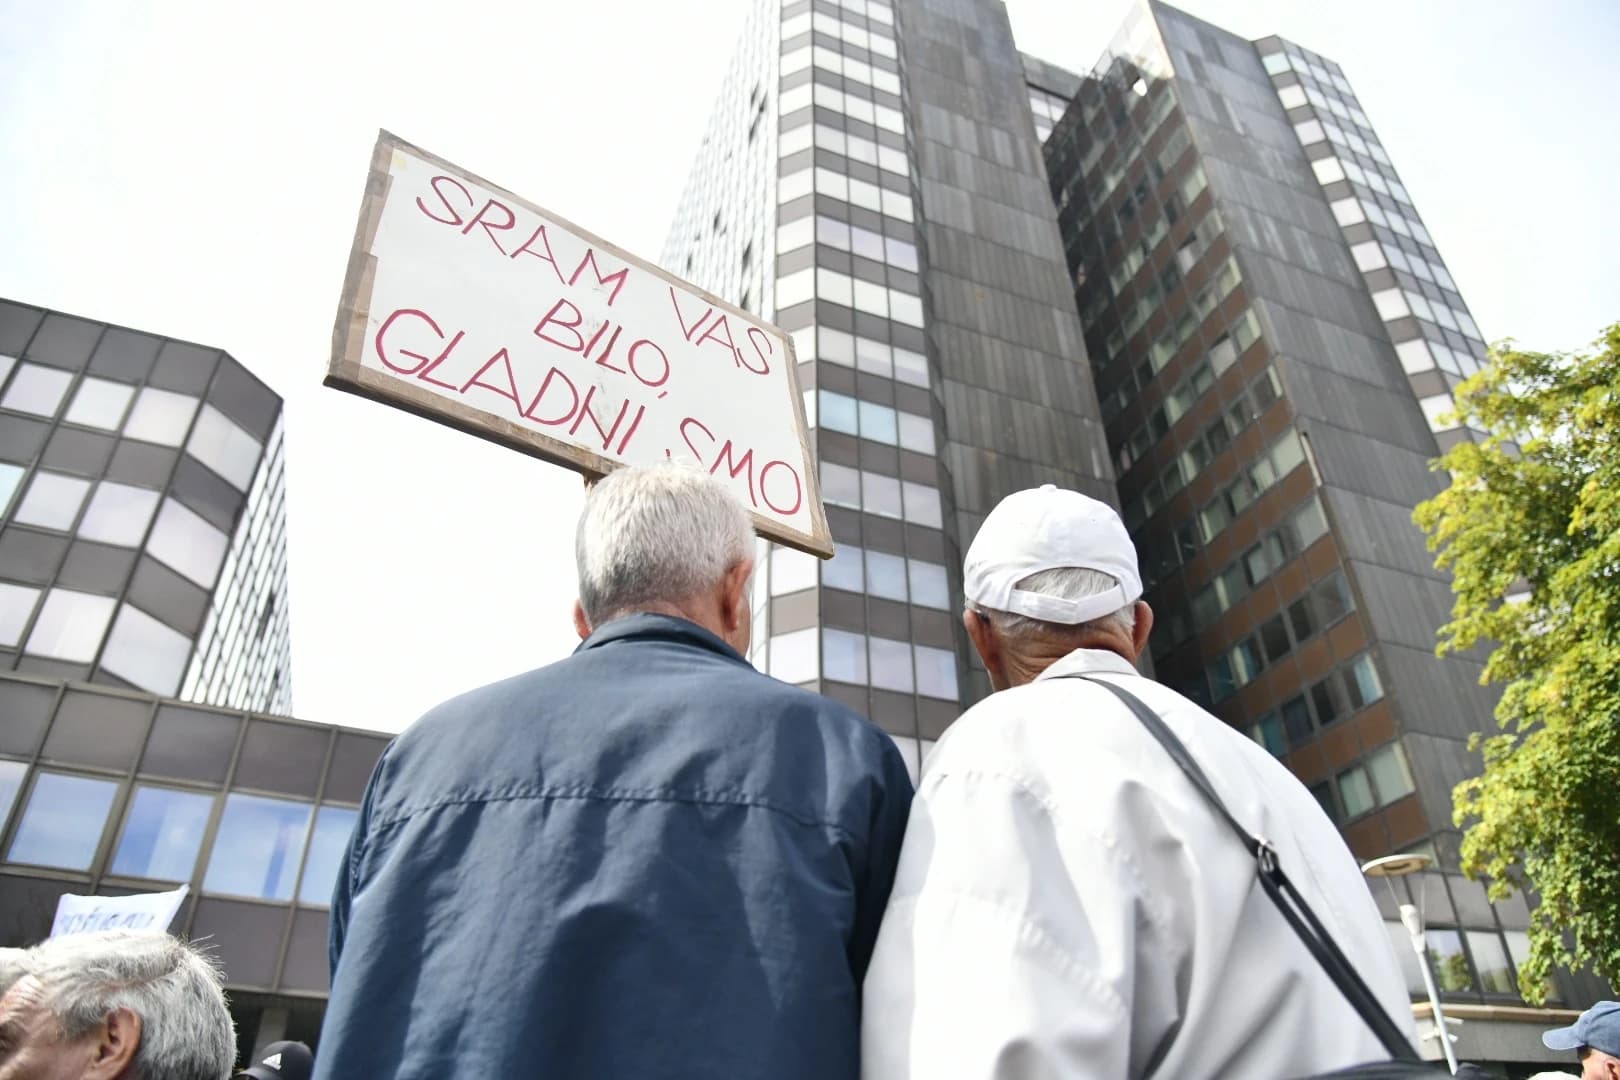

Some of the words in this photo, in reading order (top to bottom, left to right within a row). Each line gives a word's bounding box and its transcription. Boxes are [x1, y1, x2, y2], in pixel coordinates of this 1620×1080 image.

[416, 175, 629, 306] SRAM
[669, 286, 773, 375] VAS
[534, 298, 671, 399] BILO,
[375, 308, 646, 455] GLADNI
[665, 417, 802, 516] SMO
